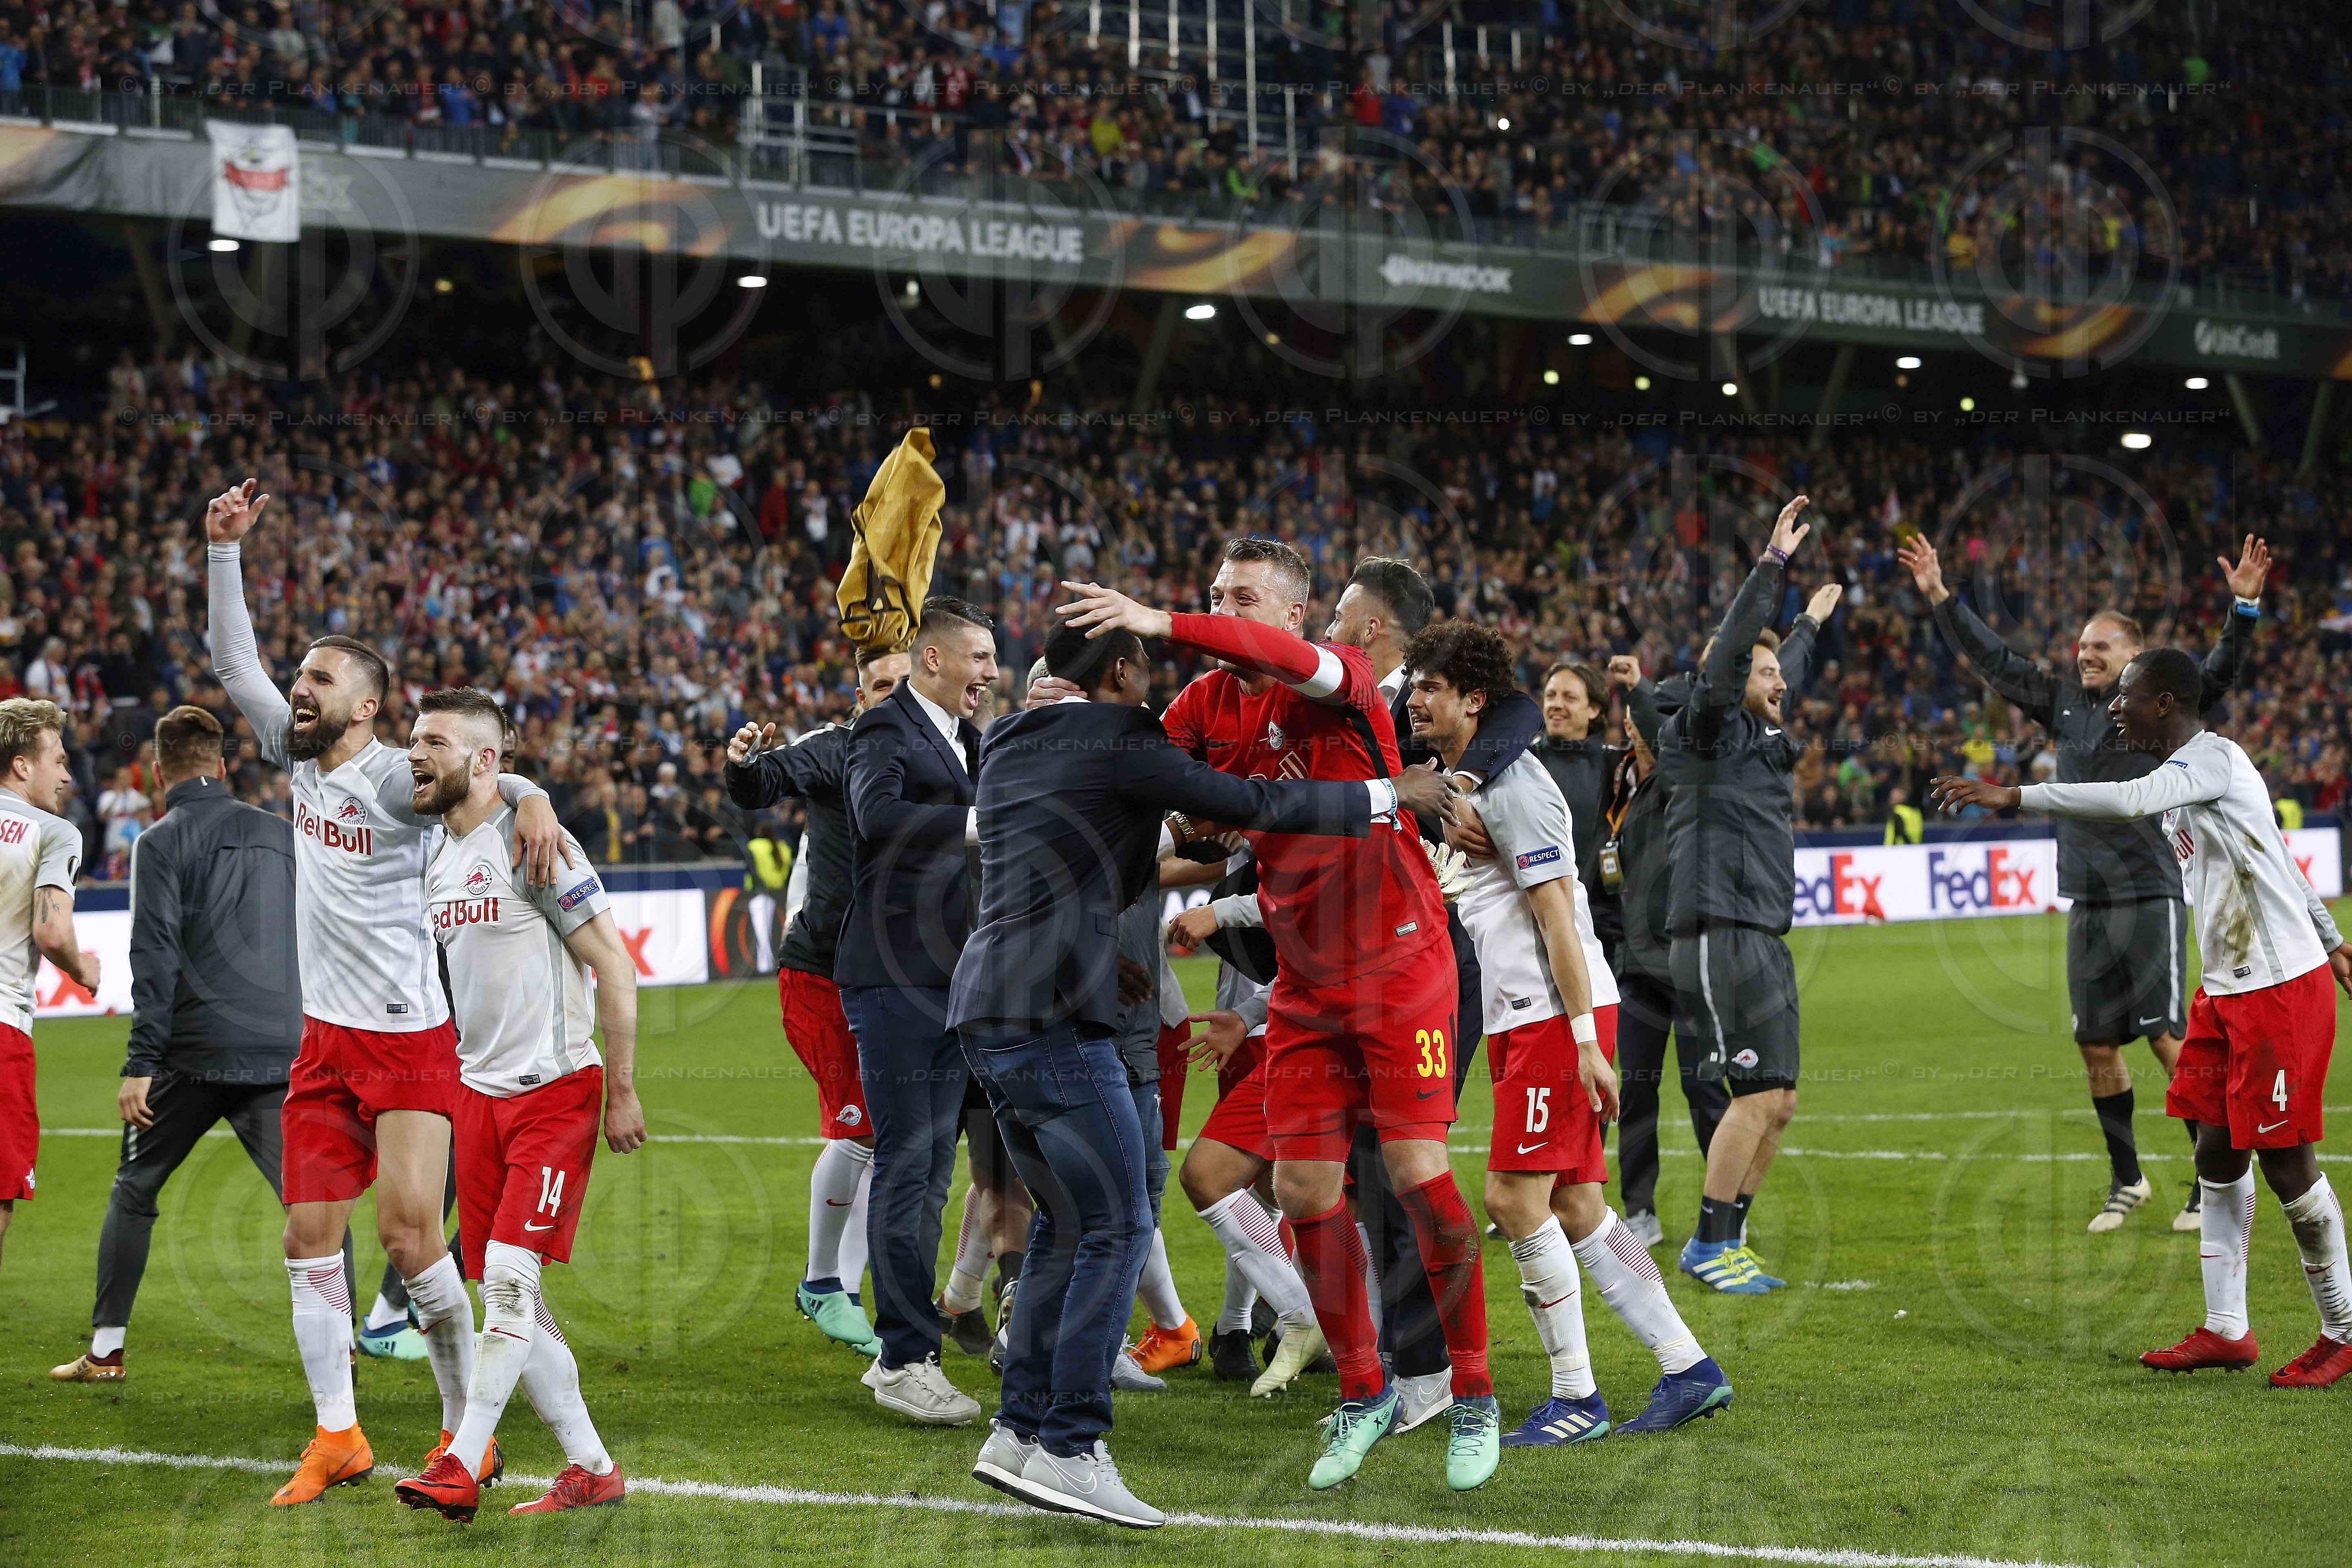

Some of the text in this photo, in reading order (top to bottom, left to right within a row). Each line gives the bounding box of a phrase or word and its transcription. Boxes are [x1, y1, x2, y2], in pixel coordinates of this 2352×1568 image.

[757, 202, 1085, 263] UEFA EUROPA LEAGUE
[1758, 287, 1818, 320] UEFA
[1820, 291, 1902, 327] EUROPA
[1387, 784, 1396, 808] LOUNGE
[0, 818, 29, 844] SEN
[295, 803, 372, 855] Red Bull
[2175, 829, 2195, 862] ull
[1529, 849, 1558, 863] RESPECT
[571, 881, 597, 901] RESPECT
[1794, 855, 1884, 918] edEx
[1929, 849, 2036, 909] FedEx
[434, 897, 499, 933] ed Bull
[1416, 1029, 1446, 1078] 33
[1526, 1087, 1550, 1133] 15
[2272, 1069, 2287, 1111] 4
[537, 1166, 566, 1217] 14
